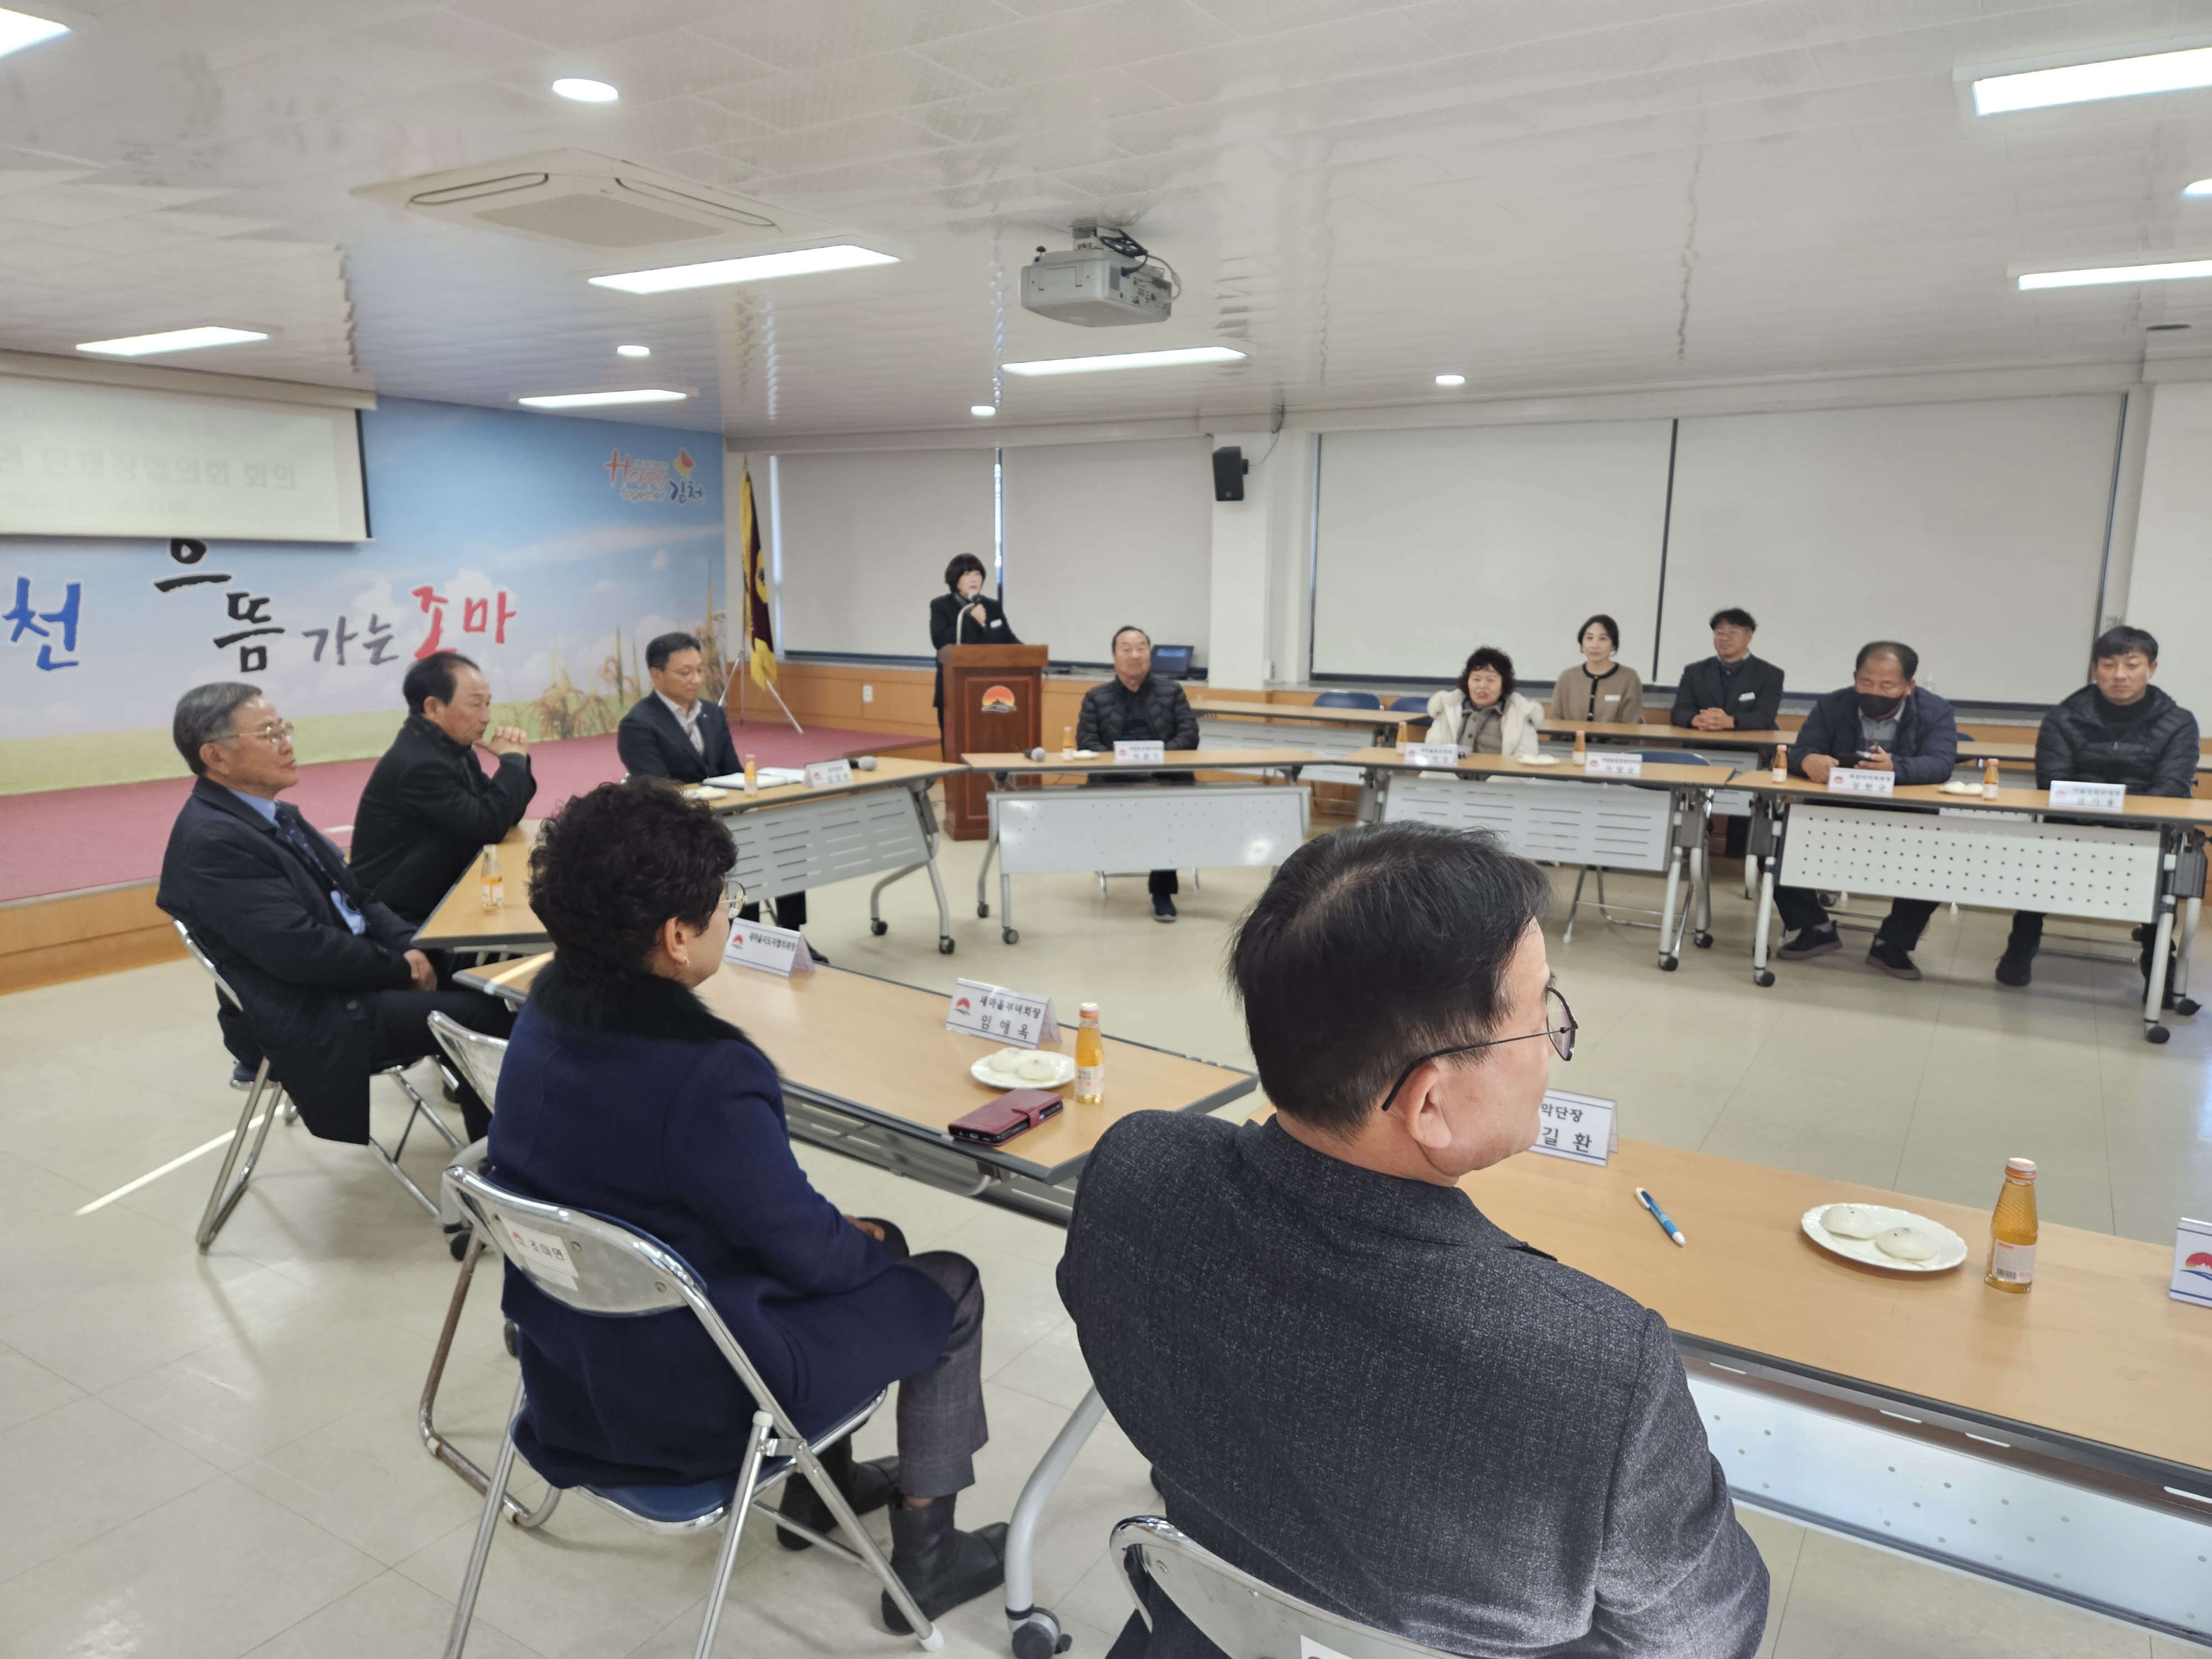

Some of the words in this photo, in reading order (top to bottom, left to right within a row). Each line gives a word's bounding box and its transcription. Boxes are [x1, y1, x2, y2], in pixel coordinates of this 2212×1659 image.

[244, 462, 297, 491] 회의
[606, 448, 667, 487] Happy
[669, 479, 706, 504] 김천
[2, 576, 81, 671] 천
[302, 614, 399, 666] 가는
[411, 586, 518, 660] 조마
[749, 932, 797, 952] 새마을지도자협의회장
[979, 995, 1041, 1019] 새마을부녀회장
[1541, 1103, 1583, 1123] 악단장
[528, 1239, 565, 1261] 조마면
